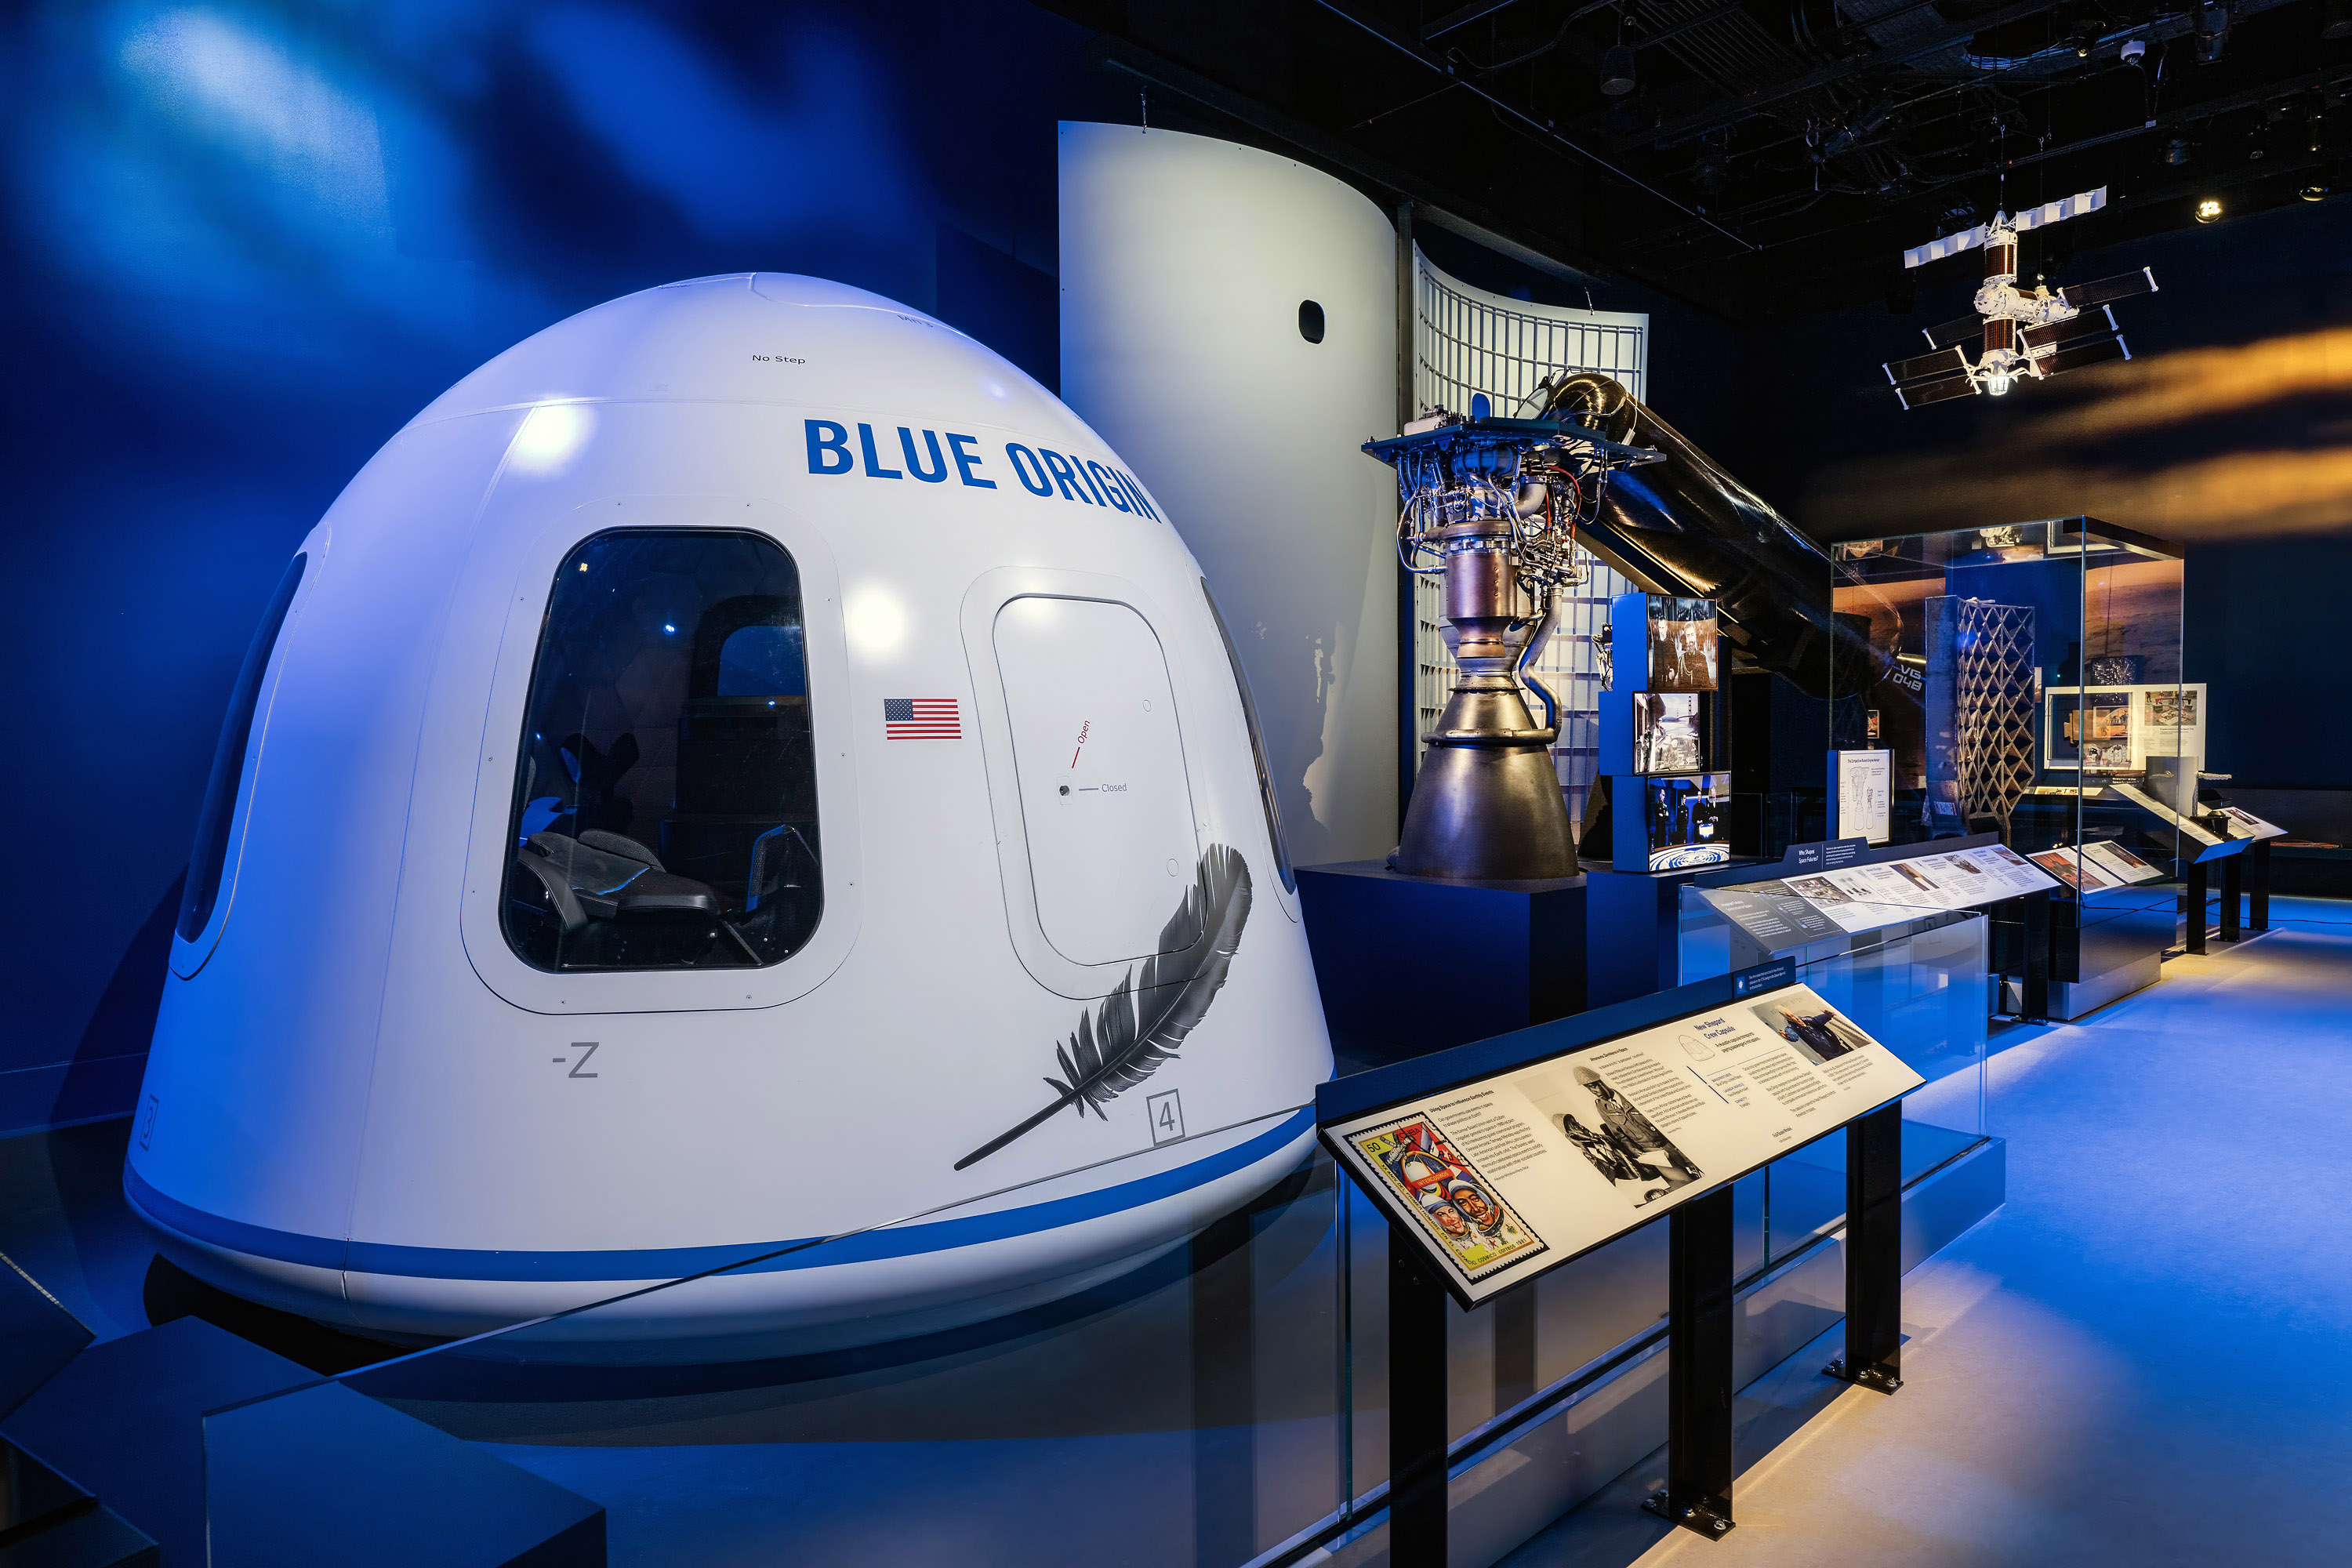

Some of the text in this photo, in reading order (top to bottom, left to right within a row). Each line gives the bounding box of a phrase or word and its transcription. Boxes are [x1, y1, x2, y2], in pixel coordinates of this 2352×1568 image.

[775, 356, 806, 365] Step
[804, 419, 1162, 524] BLUE ORIGIN
[1900, 664, 1921, 680] VG
[1892, 673, 1922, 691] 048
[1078, 720, 1091, 744] Open
[1102, 782, 1127, 793] Closed
[552, 1042, 599, 1078] -Z
[144, 1106, 153, 1139] 3
[1159, 1102, 1175, 1131] 4
[1399, 1128, 1420, 1139] CUBA
[1367, 1142, 1381, 1152] 50
[1417, 1171, 1449, 1186] INTERCOSMOS
[1406, 1192, 1423, 1210] PRIMER
